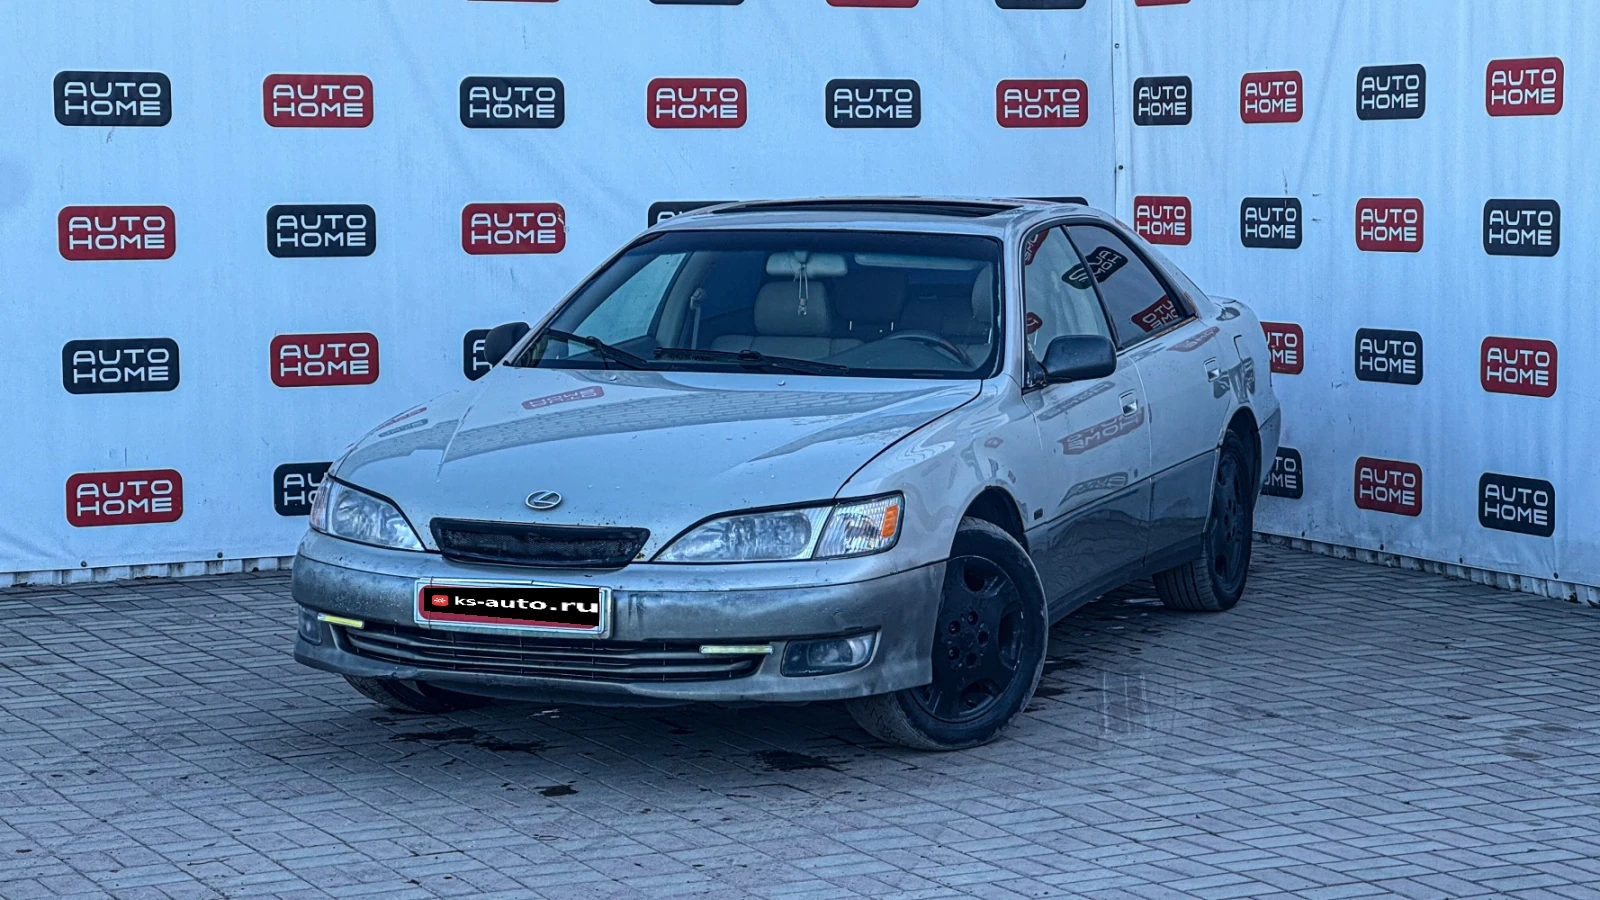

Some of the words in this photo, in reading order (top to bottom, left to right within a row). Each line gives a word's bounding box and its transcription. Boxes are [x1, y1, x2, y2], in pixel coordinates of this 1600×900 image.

[1361, 74, 1420, 92] AUTO
[1491, 68, 1557, 87] AUTO
[64, 81, 162, 98] AUTO
[272, 84, 364, 100] AUTO
[469, 86, 556, 103] AUTO
[656, 87, 739, 103] AUTO
[833, 88, 913, 103] AUTO
[1004, 88, 1081, 103] AUTO
[1138, 85, 1187, 101] AUTO
[1245, 80, 1298, 97] AUTO
[1491, 87, 1556, 106] HOME
[64, 99, 161, 116] HOME
[273, 101, 364, 118] HOME
[1138, 101, 1187, 117] HOME
[1244, 97, 1297, 114] HOME
[1361, 92, 1419, 110] HOME
[469, 103, 555, 119] HOME
[655, 104, 738, 119] HOME
[833, 104, 913, 119] HOME
[1004, 104, 1080, 119] HOME
[471, 212, 557, 228] AUTO
[1137, 205, 1187, 219] AUTO
[1245, 206, 1297, 222] AUTO
[1360, 208, 1418, 224] AUTO
[1489, 209, 1554, 227] AUTO
[68, 216, 166, 232] AUTO
[276, 214, 367, 230] AUTO
[1137, 221, 1186, 236] HOME
[276, 231, 367, 248] HOME
[471, 229, 556, 245] HOME
[1245, 223, 1296, 239] HOME
[1360, 225, 1417, 242] HOME
[1488, 228, 1552, 246] HOME
[68, 233, 165, 250] HOME
[279, 342, 370, 360] AUTO
[1359, 338, 1417, 357] AUTO
[72, 348, 170, 366] AUTO
[1359, 355, 1416, 375] HOME
[1487, 347, 1551, 368] AUTO
[73, 365, 169, 384] HOME
[280, 359, 370, 377] HOME
[1486, 365, 1549, 387] HOME
[1275, 456, 1297, 473] TO
[283, 472, 321, 489] AU
[1359, 467, 1416, 488] AUTO
[76, 479, 173, 499] AUTO
[1359, 484, 1416, 506] HOME
[1484, 483, 1549, 507] AUTO
[76, 496, 173, 517] HOME
[1484, 501, 1548, 526] HOME
